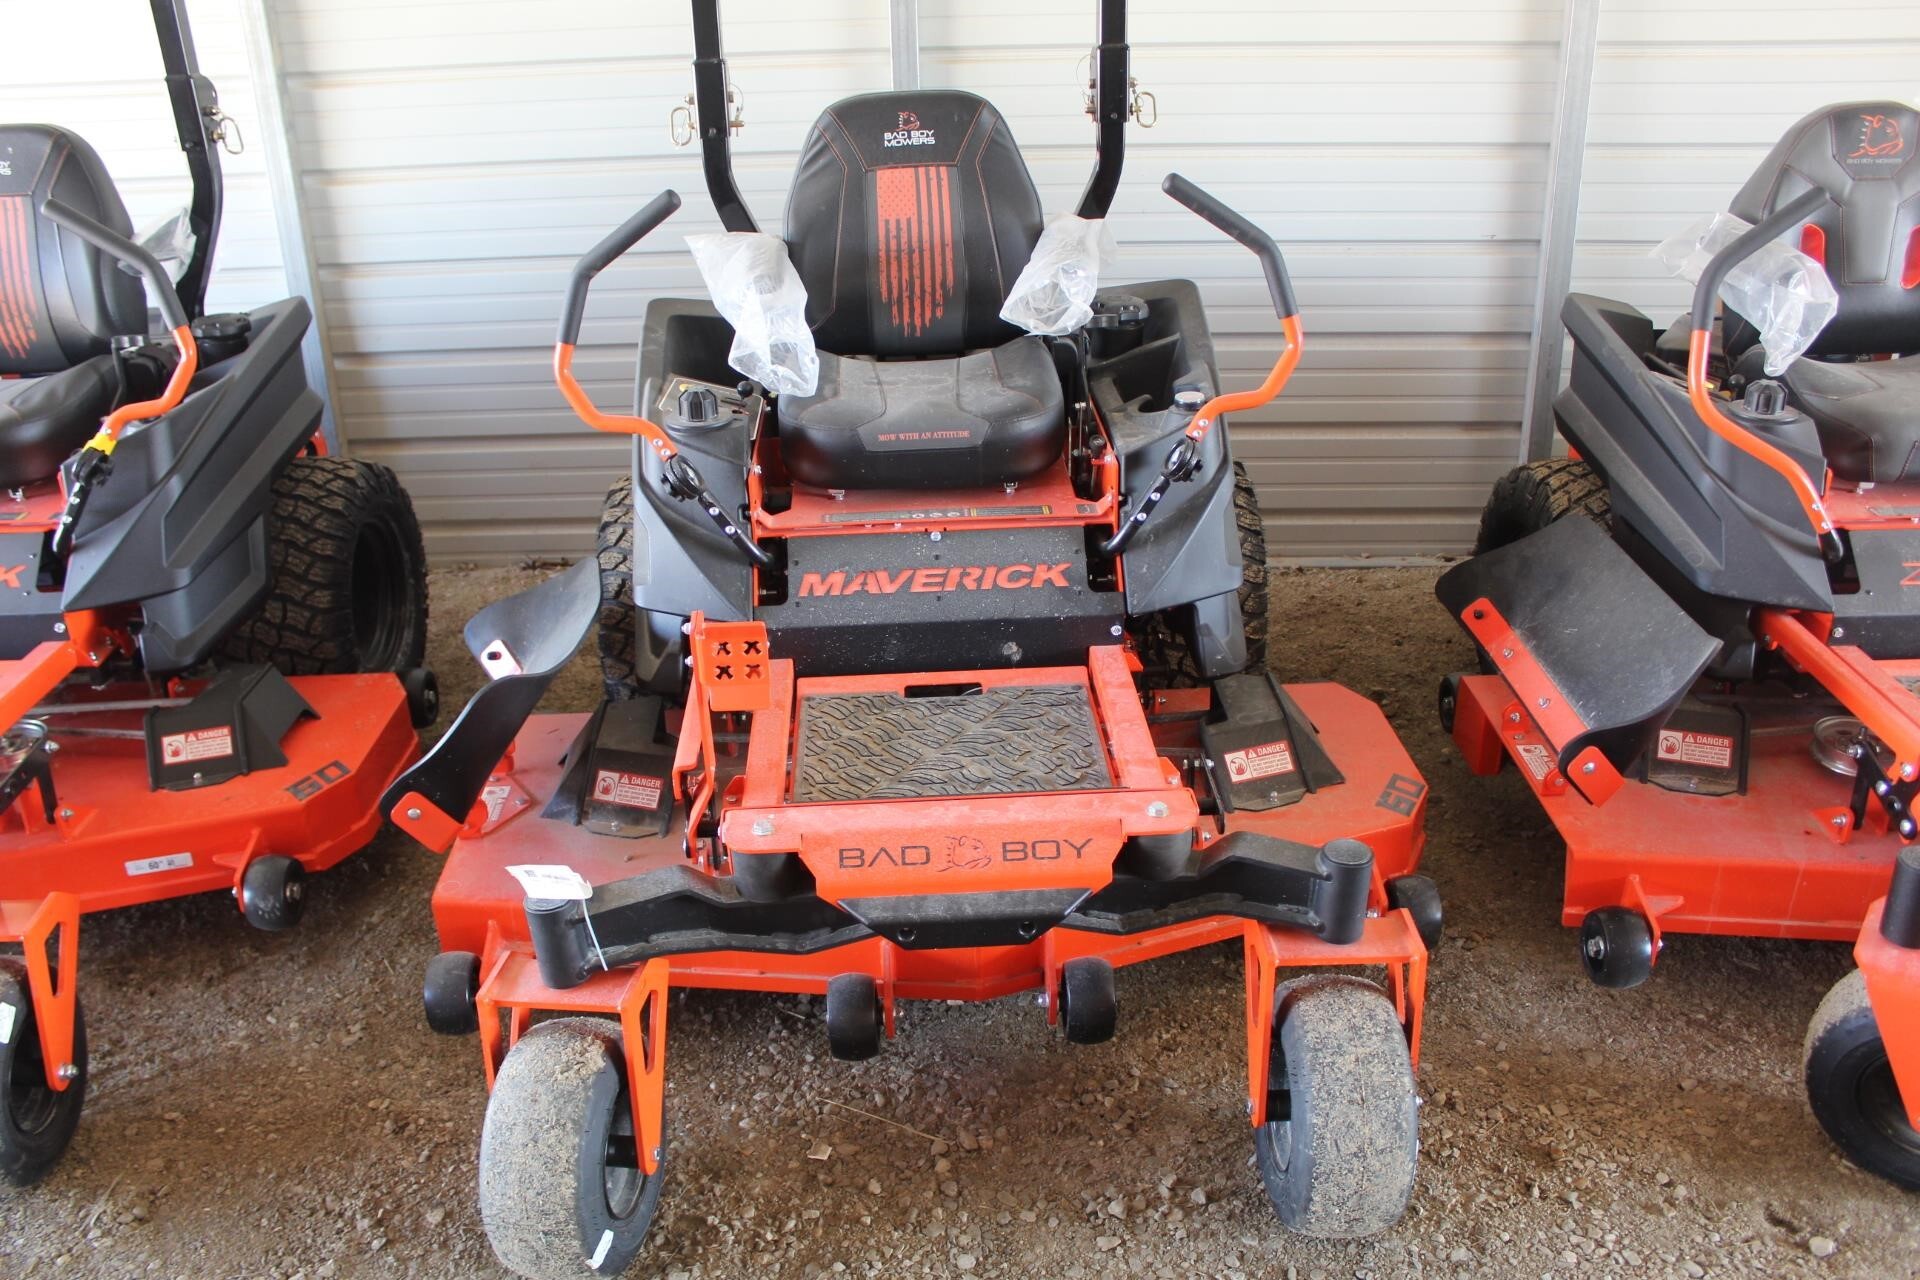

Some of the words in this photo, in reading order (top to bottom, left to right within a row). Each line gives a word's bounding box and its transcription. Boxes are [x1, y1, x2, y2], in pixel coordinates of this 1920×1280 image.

[884, 131, 907, 140] BAD
[911, 130, 934, 138] BOY
[884, 137, 936, 147] MOWERS
[878, 433, 896, 441] MOW
[899, 432, 919, 440] WITH
[921, 431, 931, 440] AN
[933, 430, 970, 439] ATTITUDE
[798, 562, 1072, 598] MAVERICK
[198, 728, 228, 740] DANGER
[1696, 735, 1729, 748] DANGER
[1257, 743, 1287, 756] DANGER
[286, 759, 351, 801] 60
[631, 776, 661, 789] DANGER
[1376, 773, 1425, 817] 60
[839, 845, 931, 869] BAD
[1002, 838, 1093, 862] BOY
